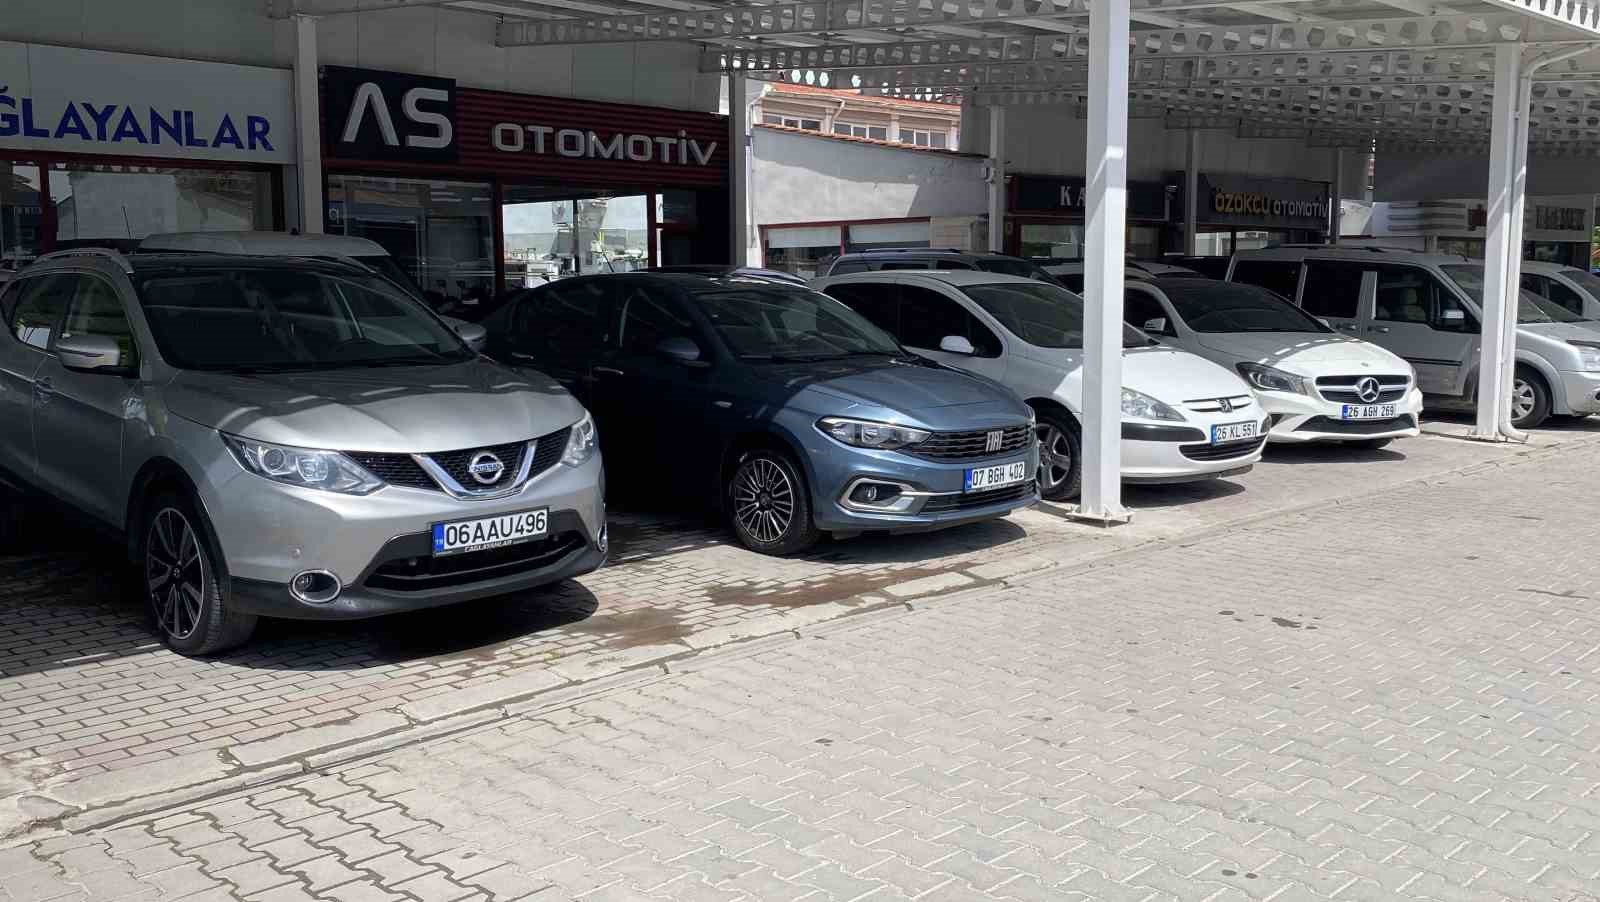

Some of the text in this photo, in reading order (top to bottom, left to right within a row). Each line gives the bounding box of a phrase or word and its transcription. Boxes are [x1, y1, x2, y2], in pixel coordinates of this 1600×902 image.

[340, 82, 454, 149] AS
[491, 122, 718, 167] OTOMOTİV
[1348, 406, 1359, 418] 26
[1363, 406, 1378, 417] AGH
[1381, 406, 1394, 417] 269
[985, 430, 1004, 452] FIAT
[1216, 427, 1227, 440] 26
[1230, 425, 1241, 439] KL
[973, 463, 1024, 486] 07 BGH 402
[446, 511, 545, 546] 06AAU496
